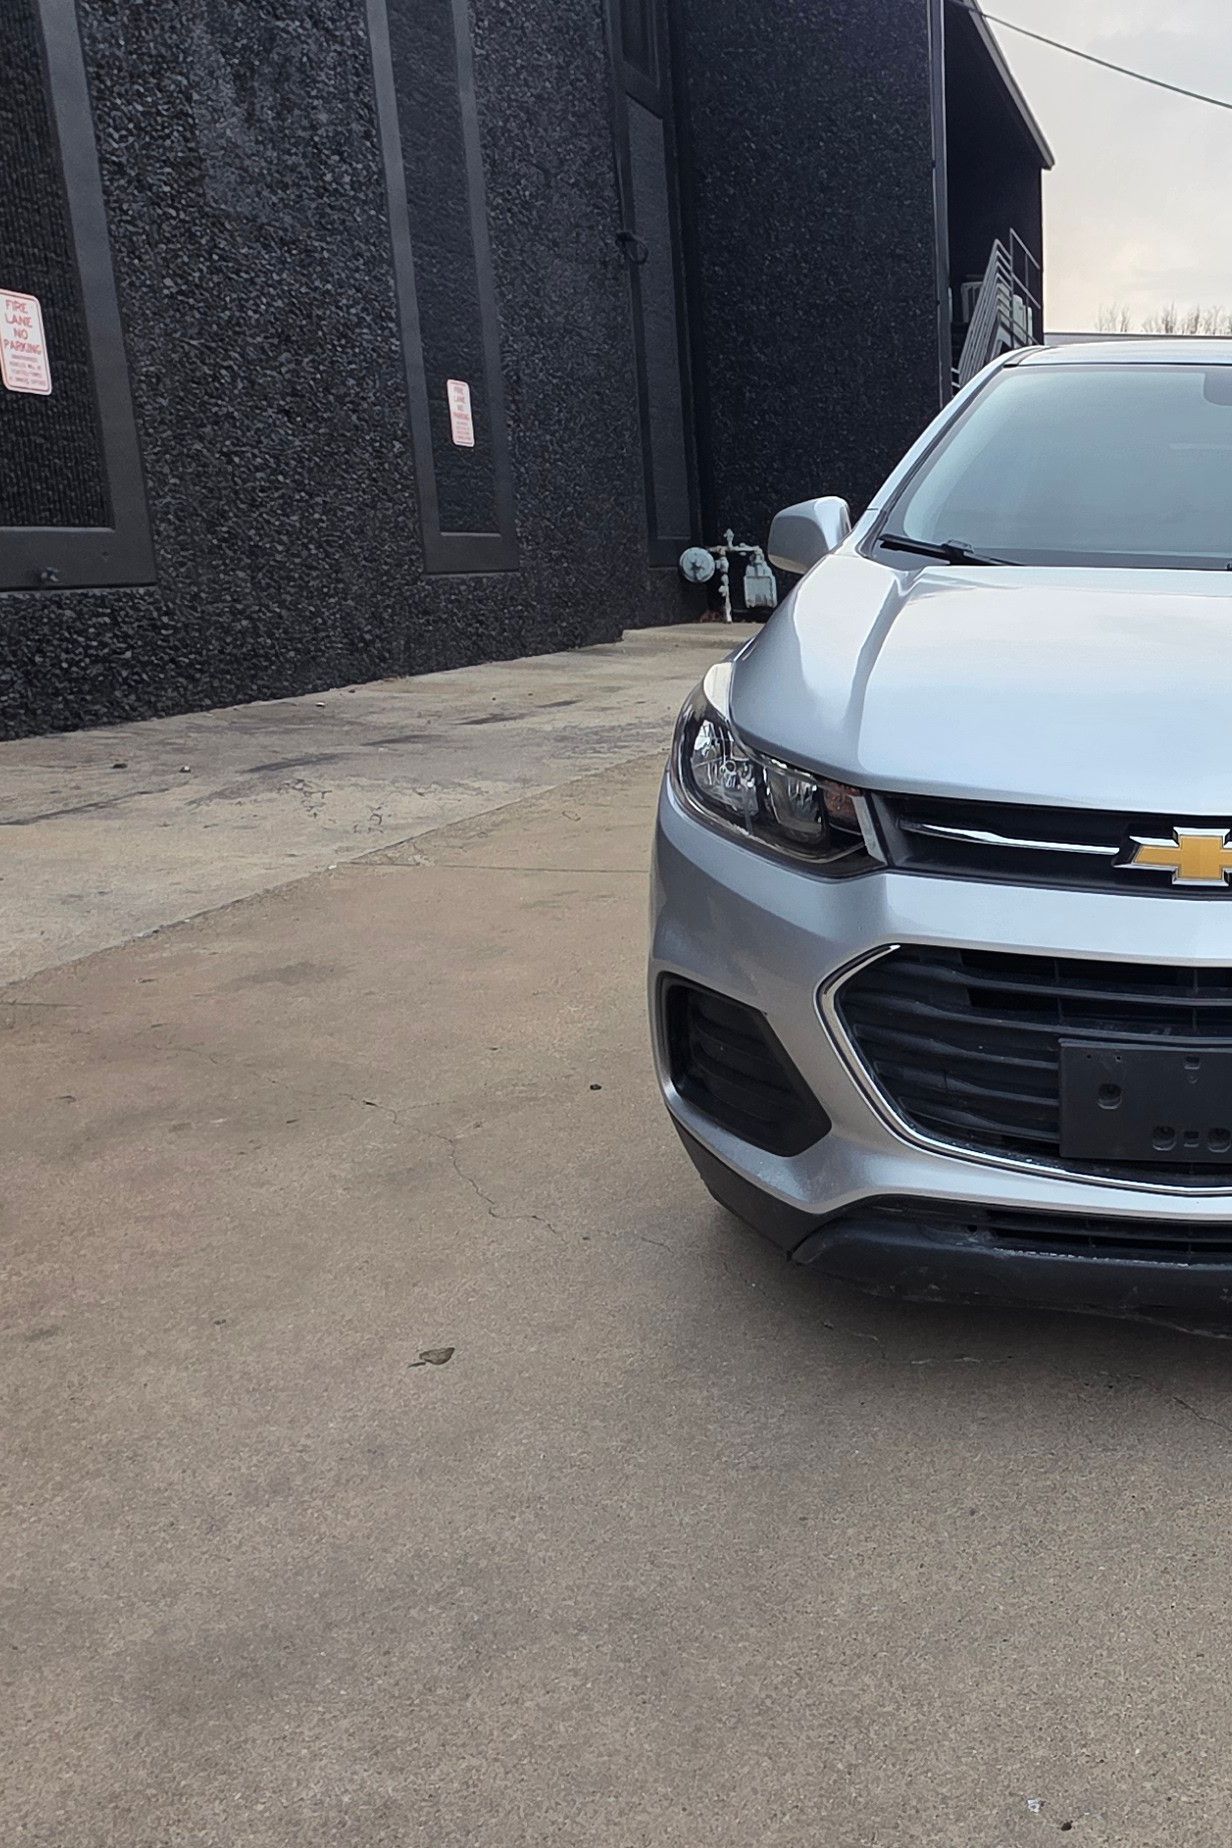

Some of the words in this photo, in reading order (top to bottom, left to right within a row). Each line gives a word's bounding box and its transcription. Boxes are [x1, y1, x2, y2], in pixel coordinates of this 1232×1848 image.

[5, 300, 28, 314] FIRE
[5, 313, 32, 327] LANE
[13, 328, 28, 340] NO
[3, 339, 41, 355] PARKING
